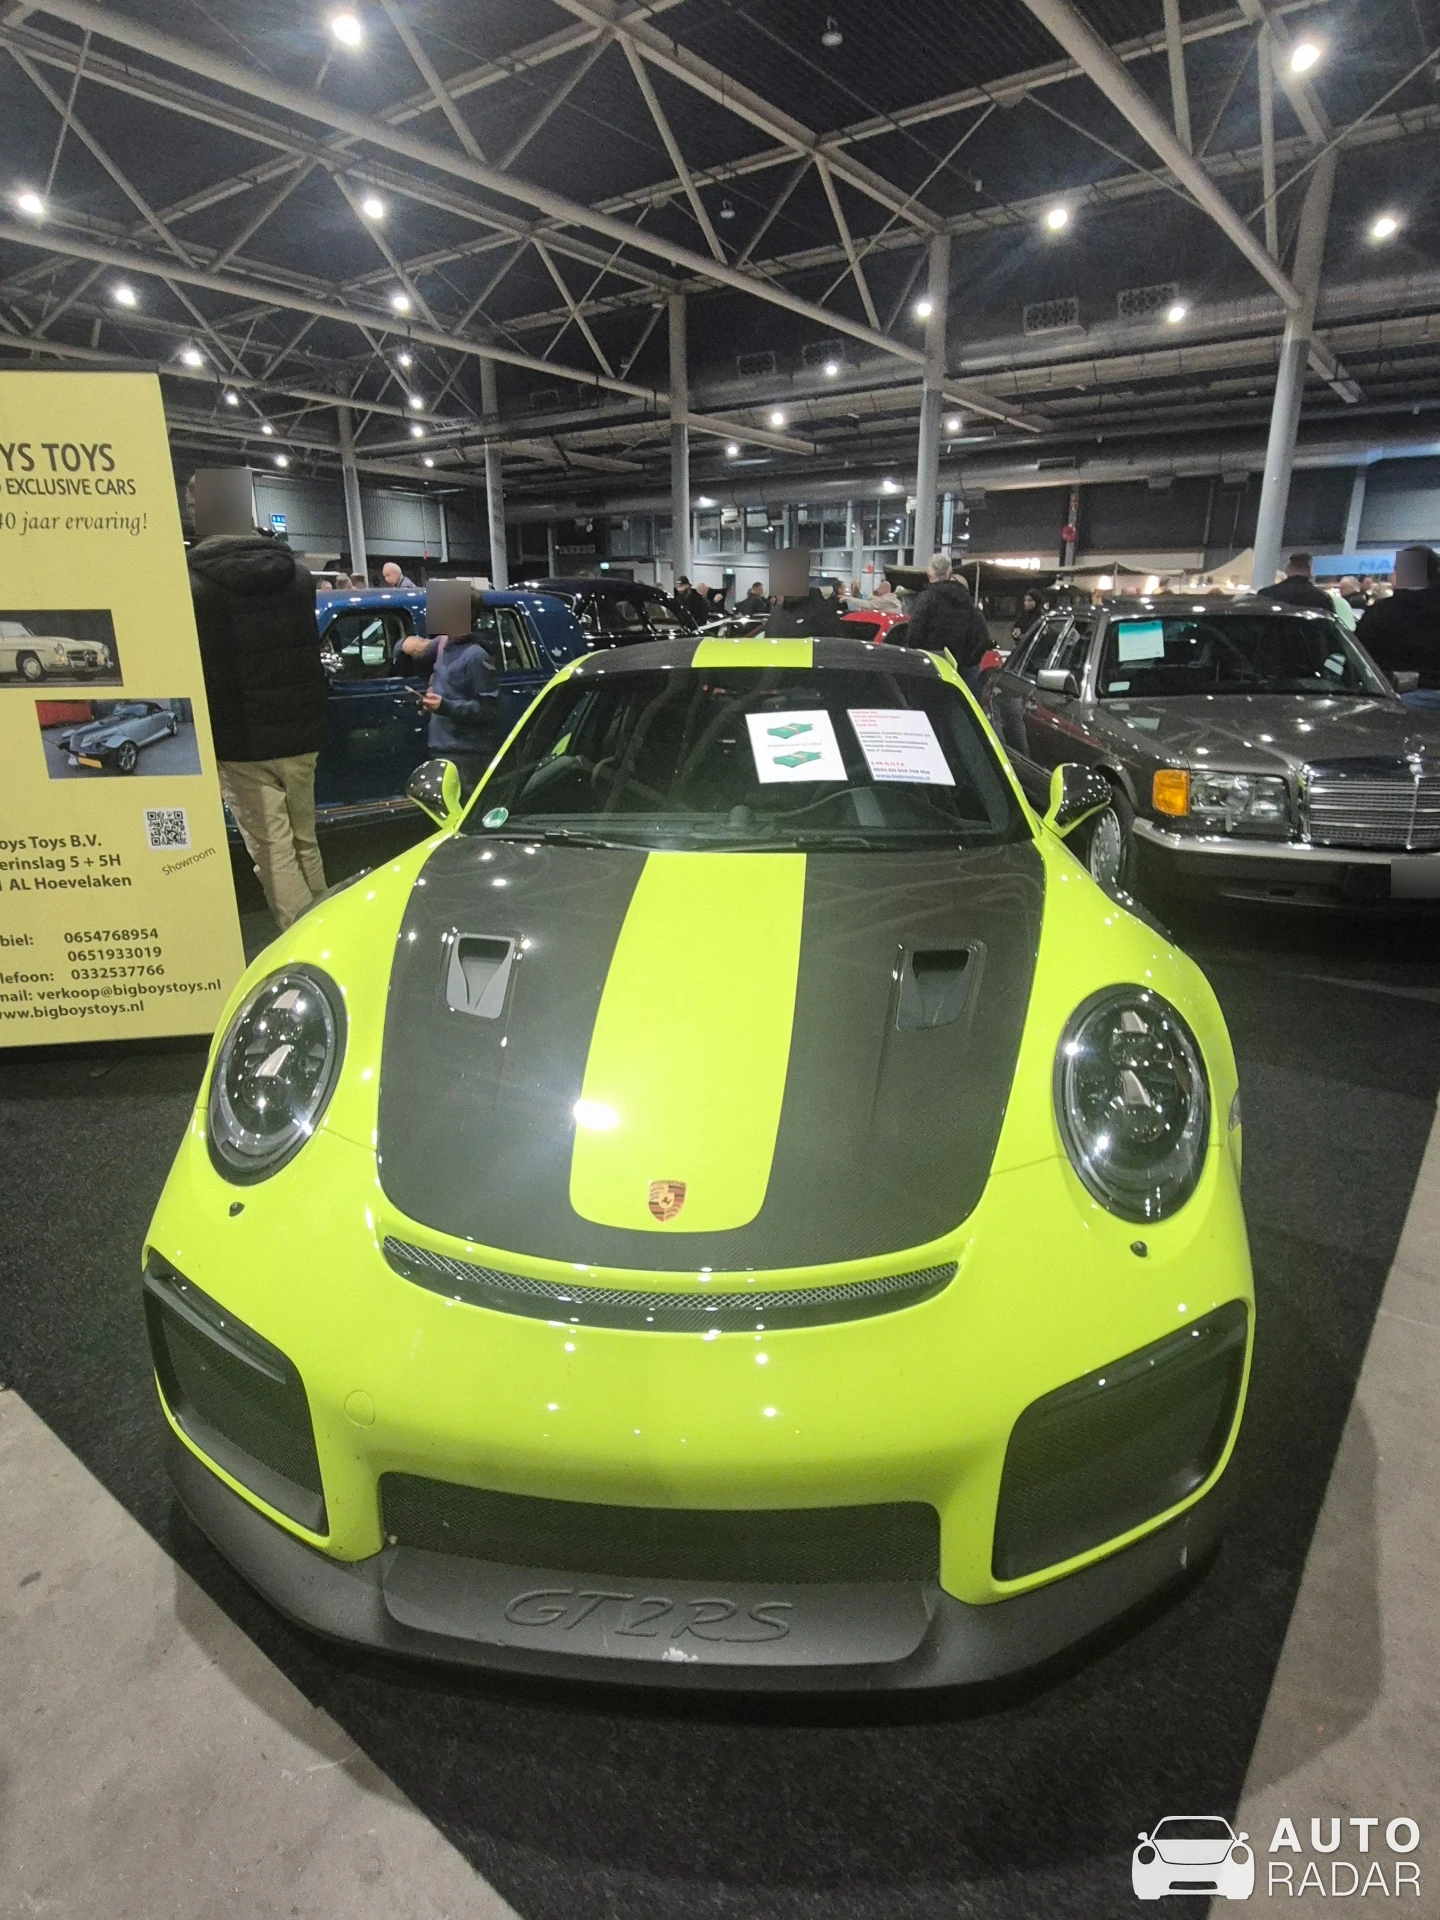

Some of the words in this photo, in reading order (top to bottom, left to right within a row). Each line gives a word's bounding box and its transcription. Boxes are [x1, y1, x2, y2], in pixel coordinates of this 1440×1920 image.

[41, 443, 116, 473] TOYS
[6, 478, 92, 496] EXCLUSIVE
[95, 478, 137, 496] CARS
[20, 511, 60, 536] jaar
[65, 511, 148, 536] ervaring!
[28, 835, 67, 852] Toys
[70, 834, 102, 848] B.V.
[0, 856, 66, 872] erinslag
[70, 856, 79, 868] 5
[84, 858, 94, 867] +
[99, 853, 121, 867] 5H
[161, 846, 216, 876] Showroom
[9, 878, 31, 891] AL
[34, 874, 132, 890] Hoevelaken
[63, 927, 159, 944] 0654768954
[67, 946, 162, 962] 0651933019
[71, 964, 165, 980] 0332537766
[37, 978, 222, 1002] verkoop@bigboystoys.nl
[0, 1000, 145, 1020] ww.bigboystoys.nl
